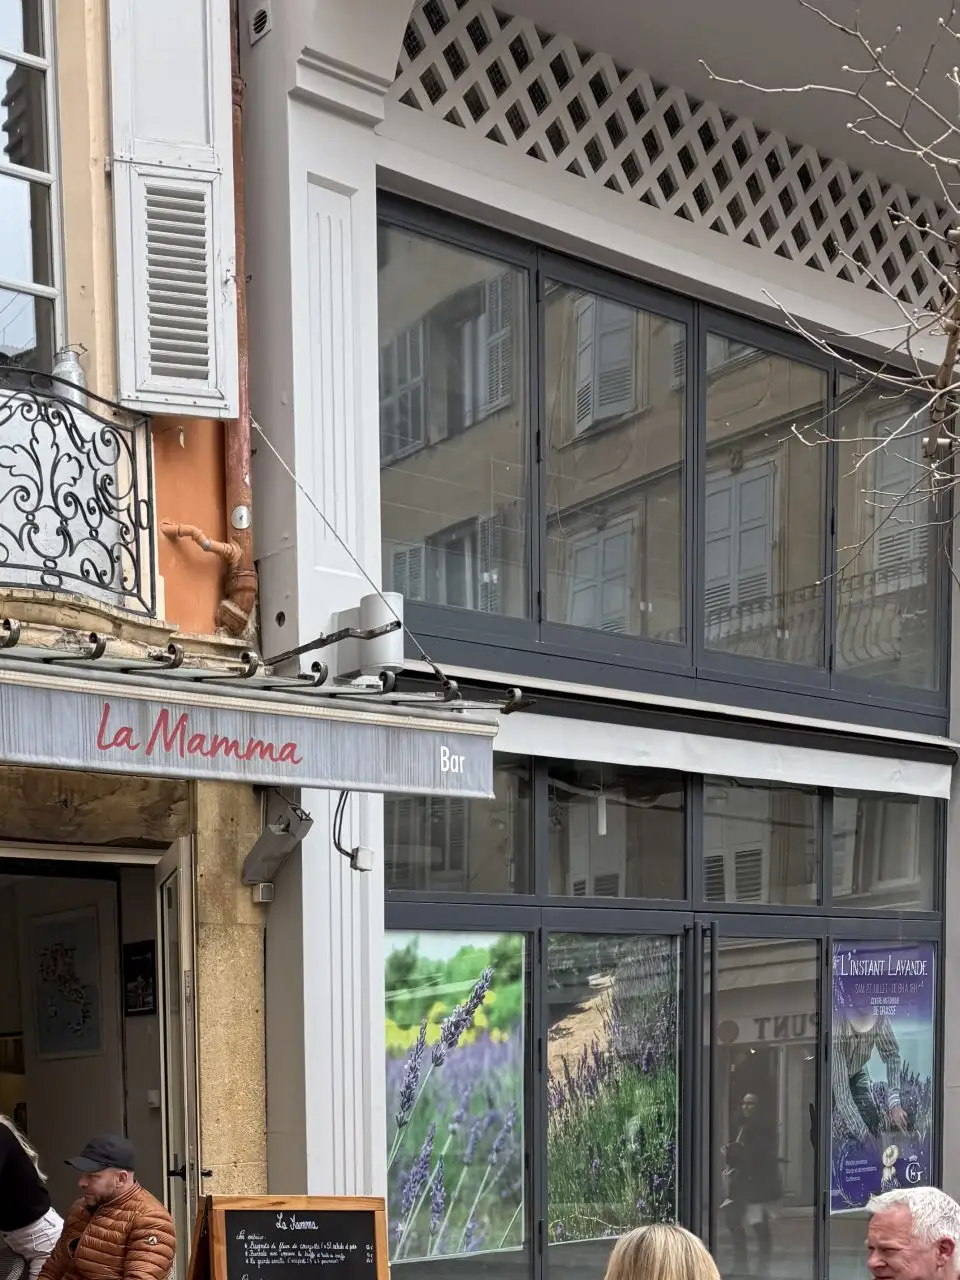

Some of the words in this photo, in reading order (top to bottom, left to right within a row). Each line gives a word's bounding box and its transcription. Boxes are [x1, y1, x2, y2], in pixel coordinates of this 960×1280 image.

[96, 702, 141, 752] La
[145, 711, 304, 765] Mamma
[439, 745, 466, 774] Bar
